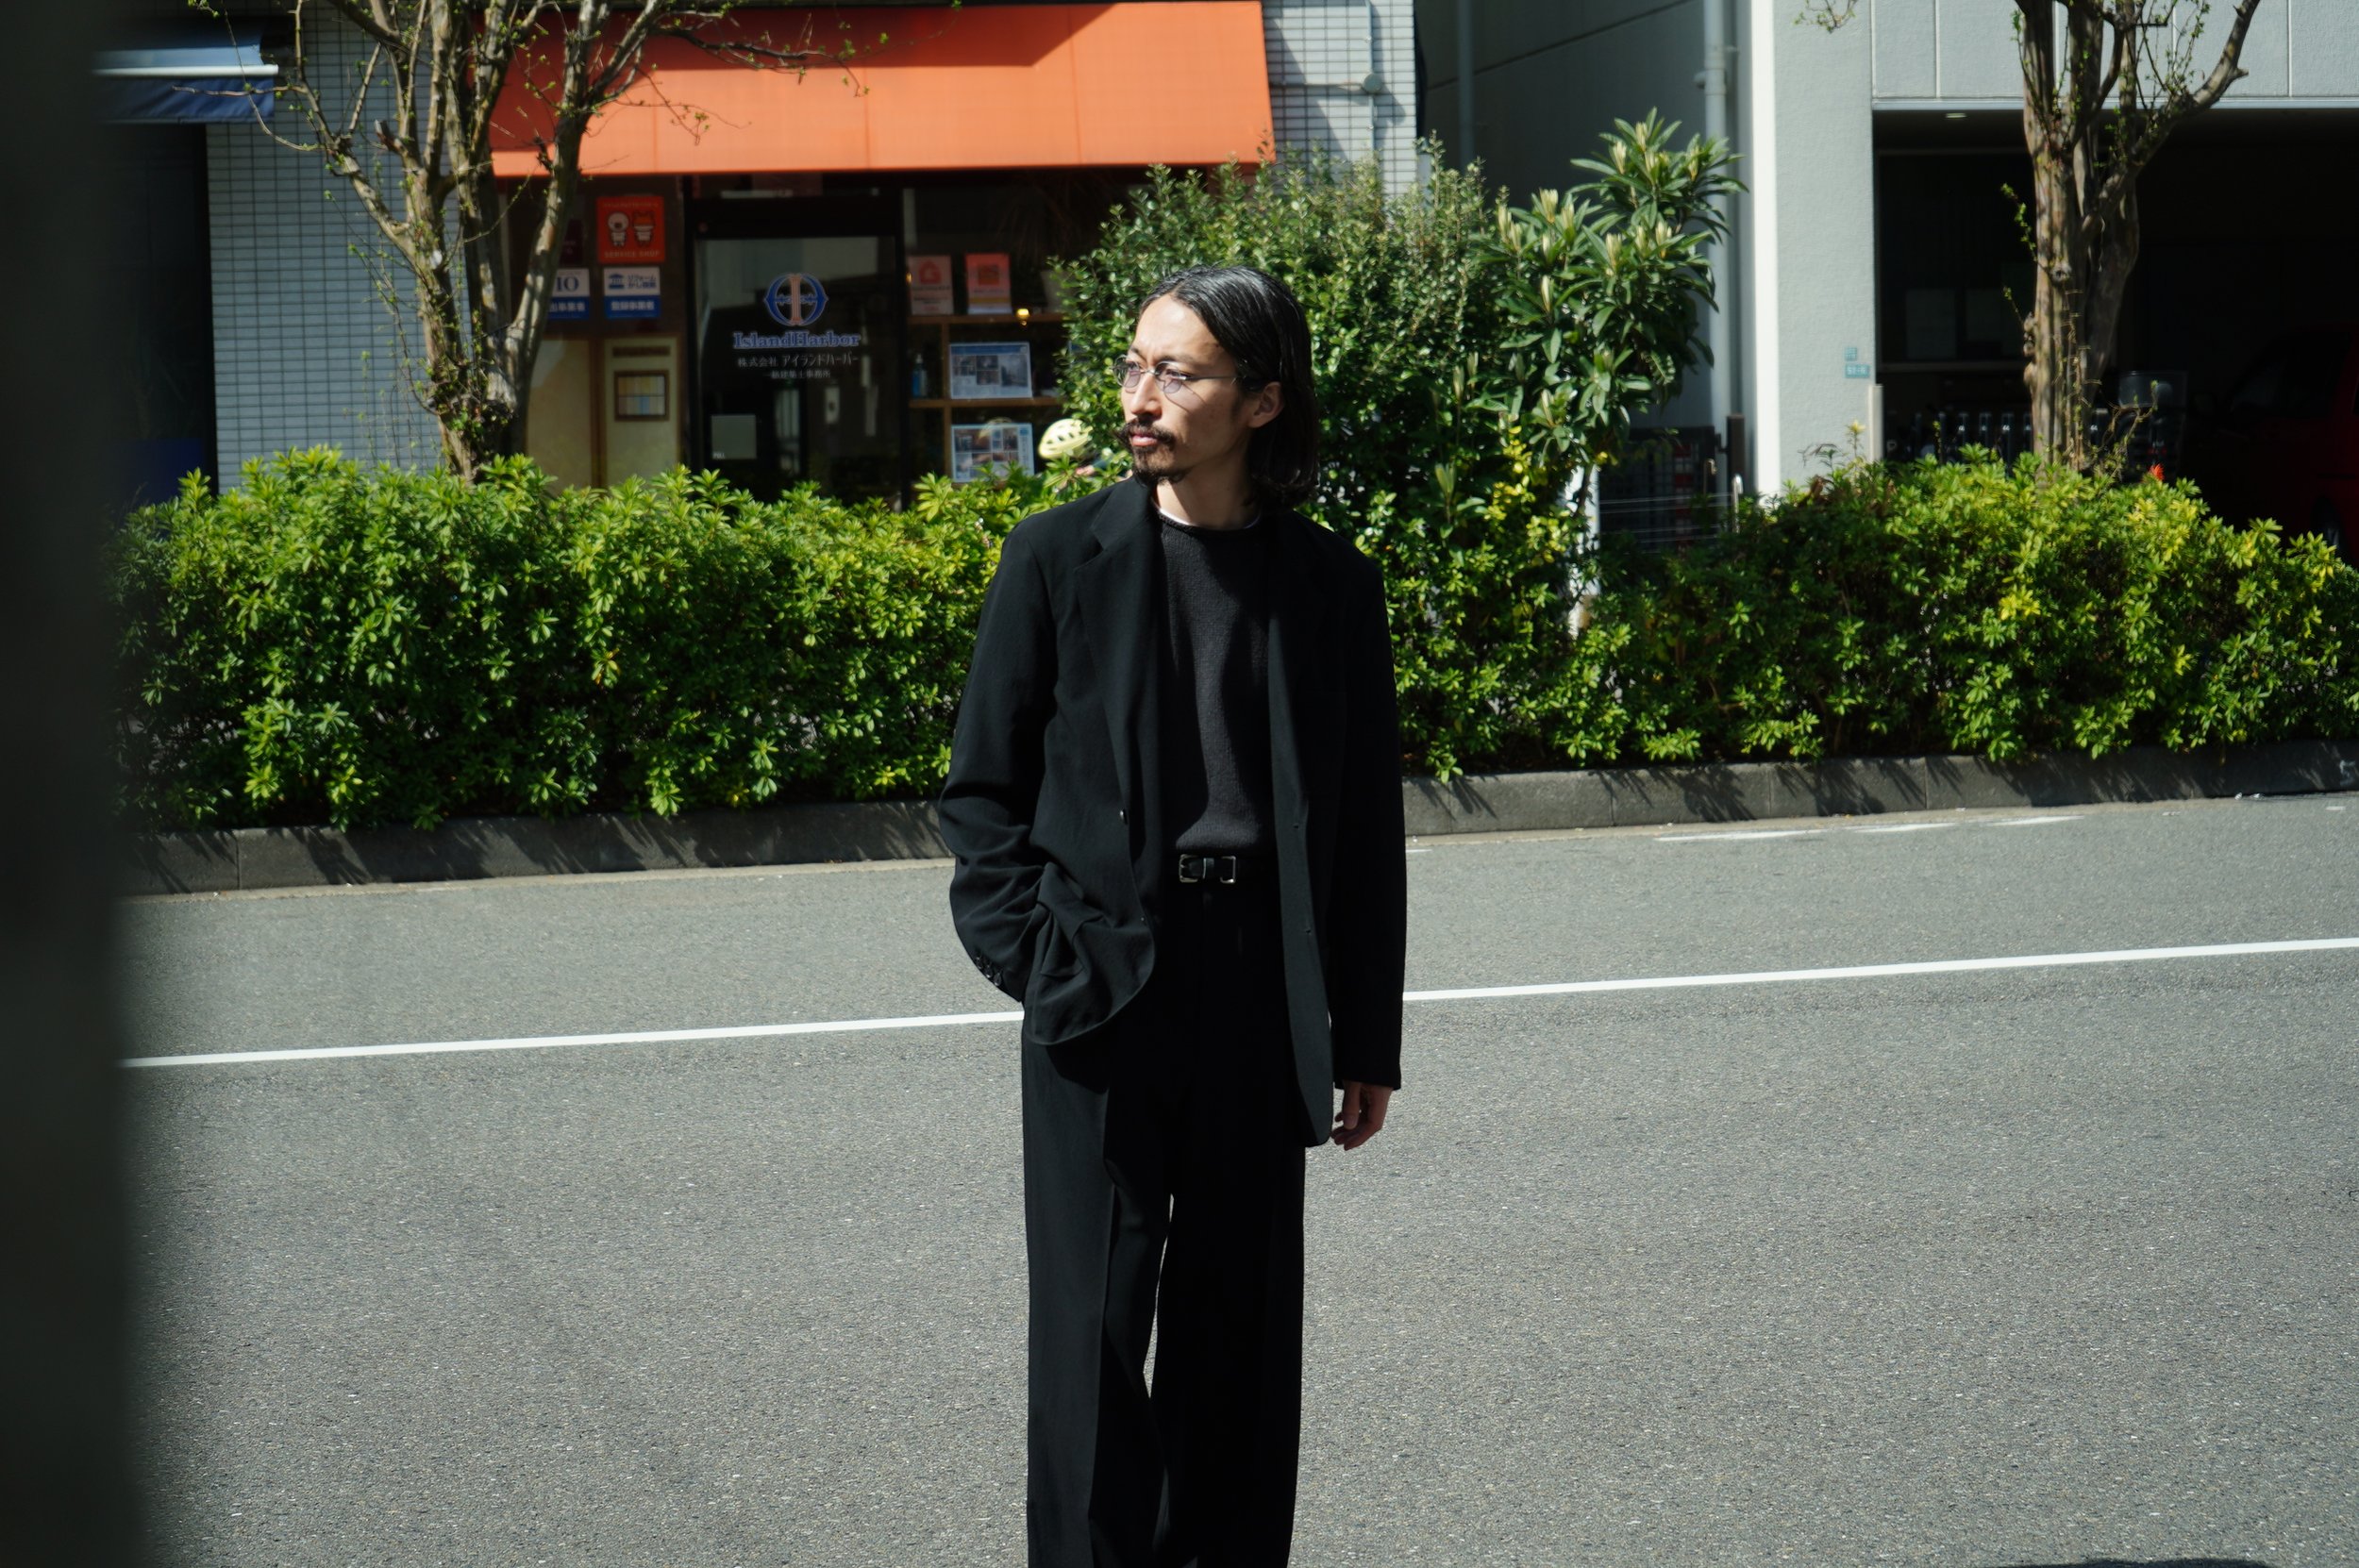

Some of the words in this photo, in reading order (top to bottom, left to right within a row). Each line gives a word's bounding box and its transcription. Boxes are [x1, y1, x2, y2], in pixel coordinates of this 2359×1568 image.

[550, 302, 586, 312] 出事業者
[611, 301, 655, 311] 登録事業者
[732, 330, 861, 349] IslandHarbor
[738, 357, 778, 368] 株式会社
[781, 351, 861, 367] アイランドハーバー
